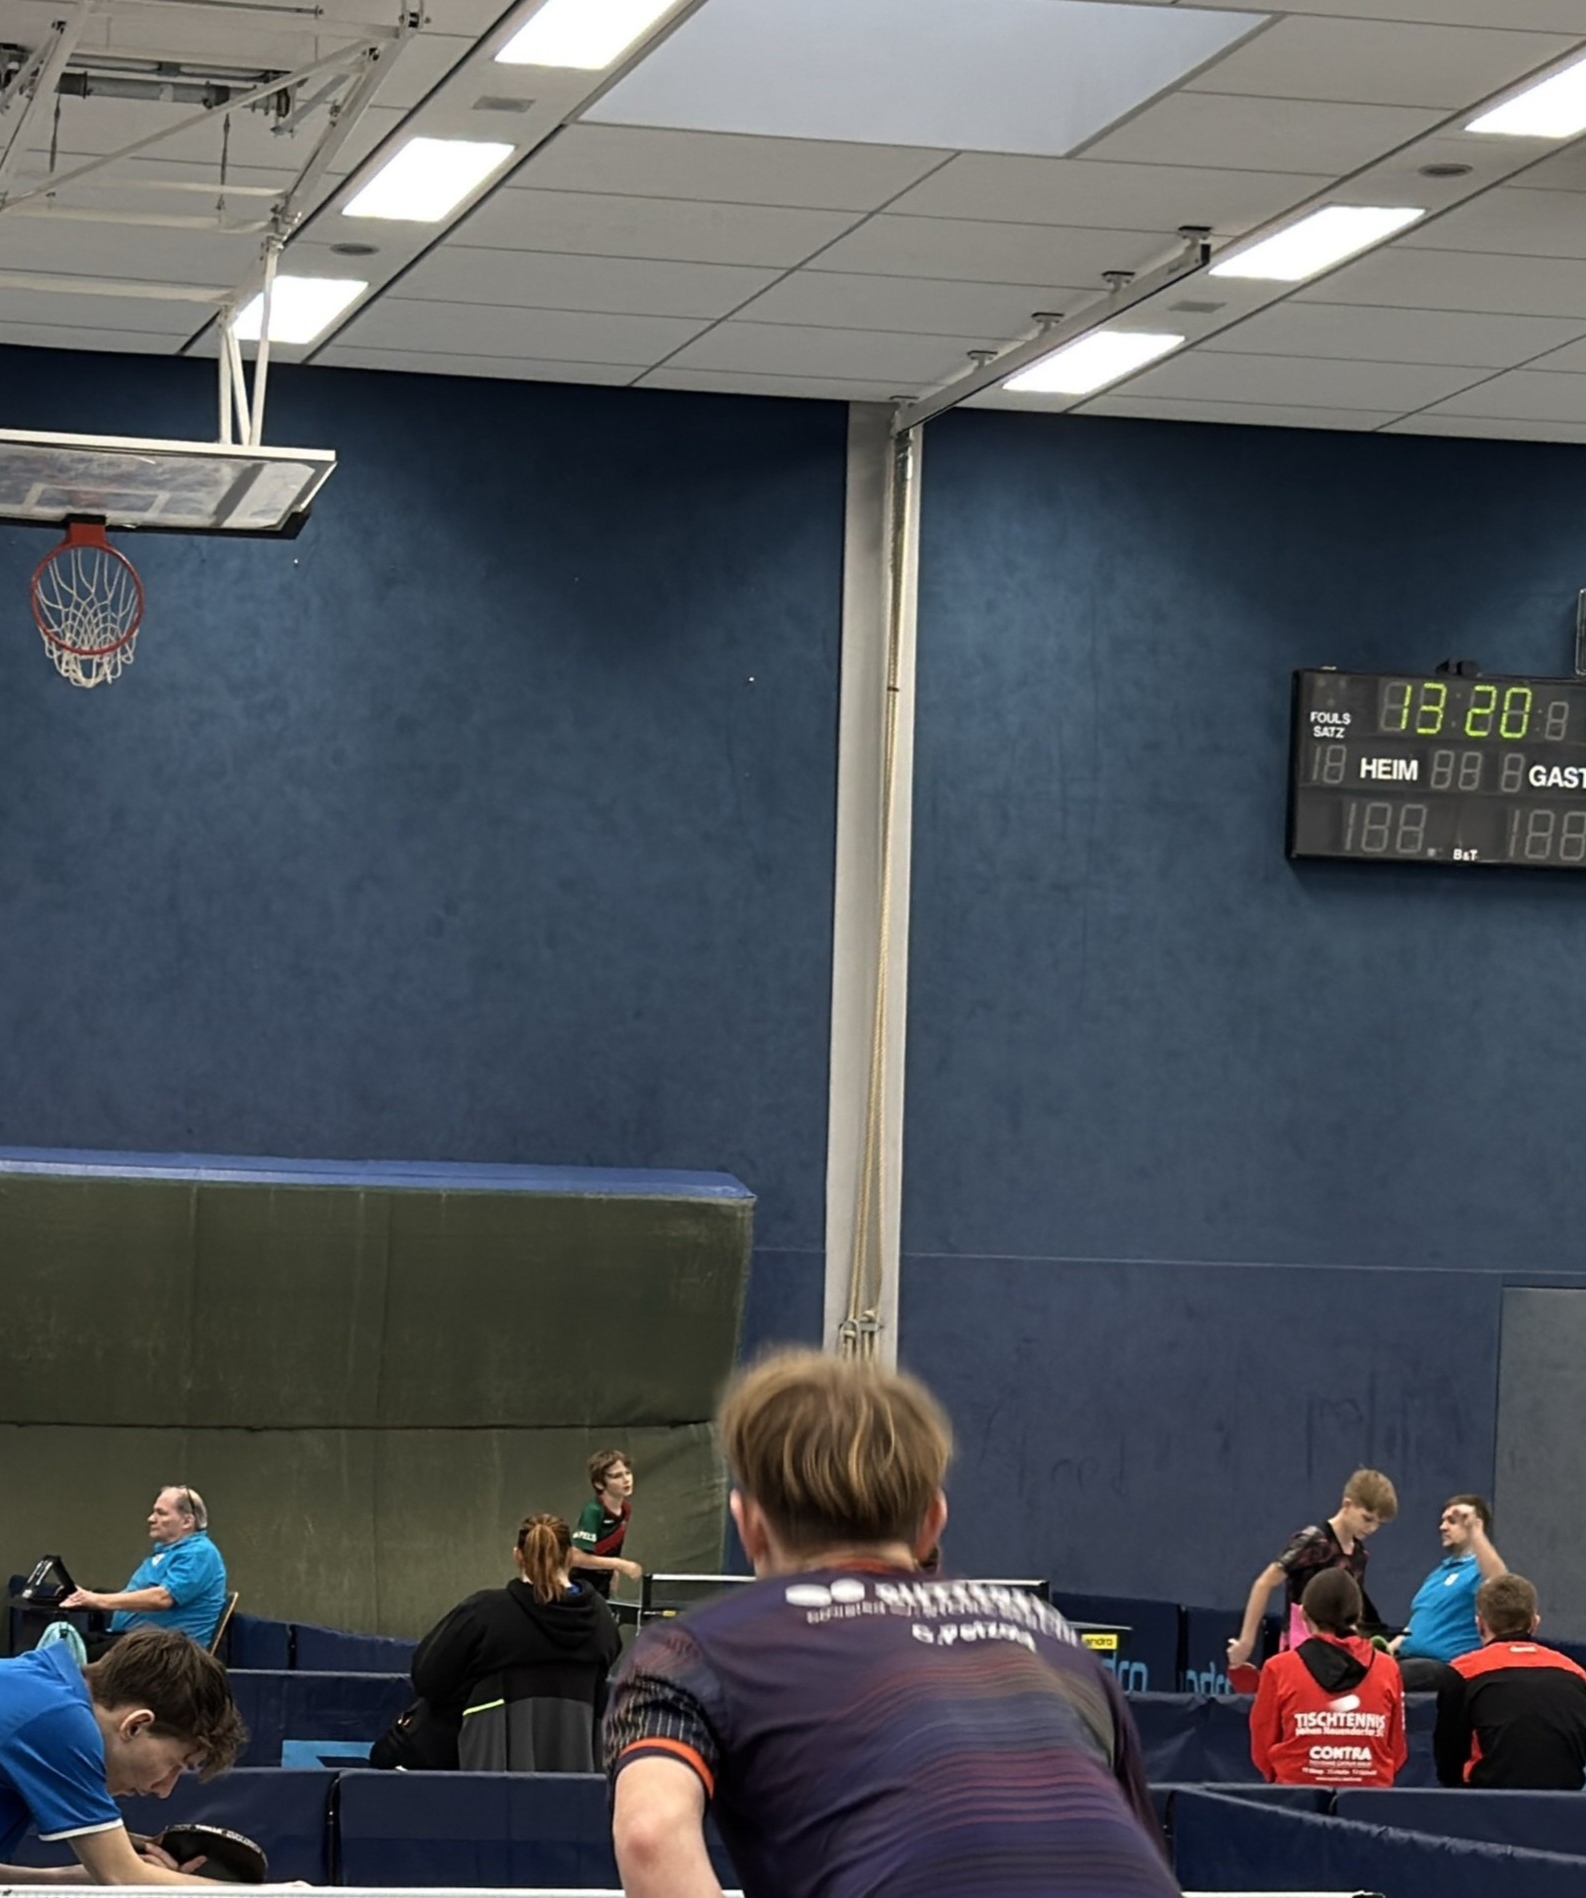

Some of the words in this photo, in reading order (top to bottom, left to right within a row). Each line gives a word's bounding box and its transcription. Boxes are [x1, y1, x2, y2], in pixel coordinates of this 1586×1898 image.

[1310, 711, 1351, 725] FOULS
[1313, 725, 1345, 739] SATZ
[1359, 757, 1419, 781] HEIM
[1294, 1711, 1386, 1730] TISCHTENNIS
[1309, 1746, 1372, 1760] CONTRA
